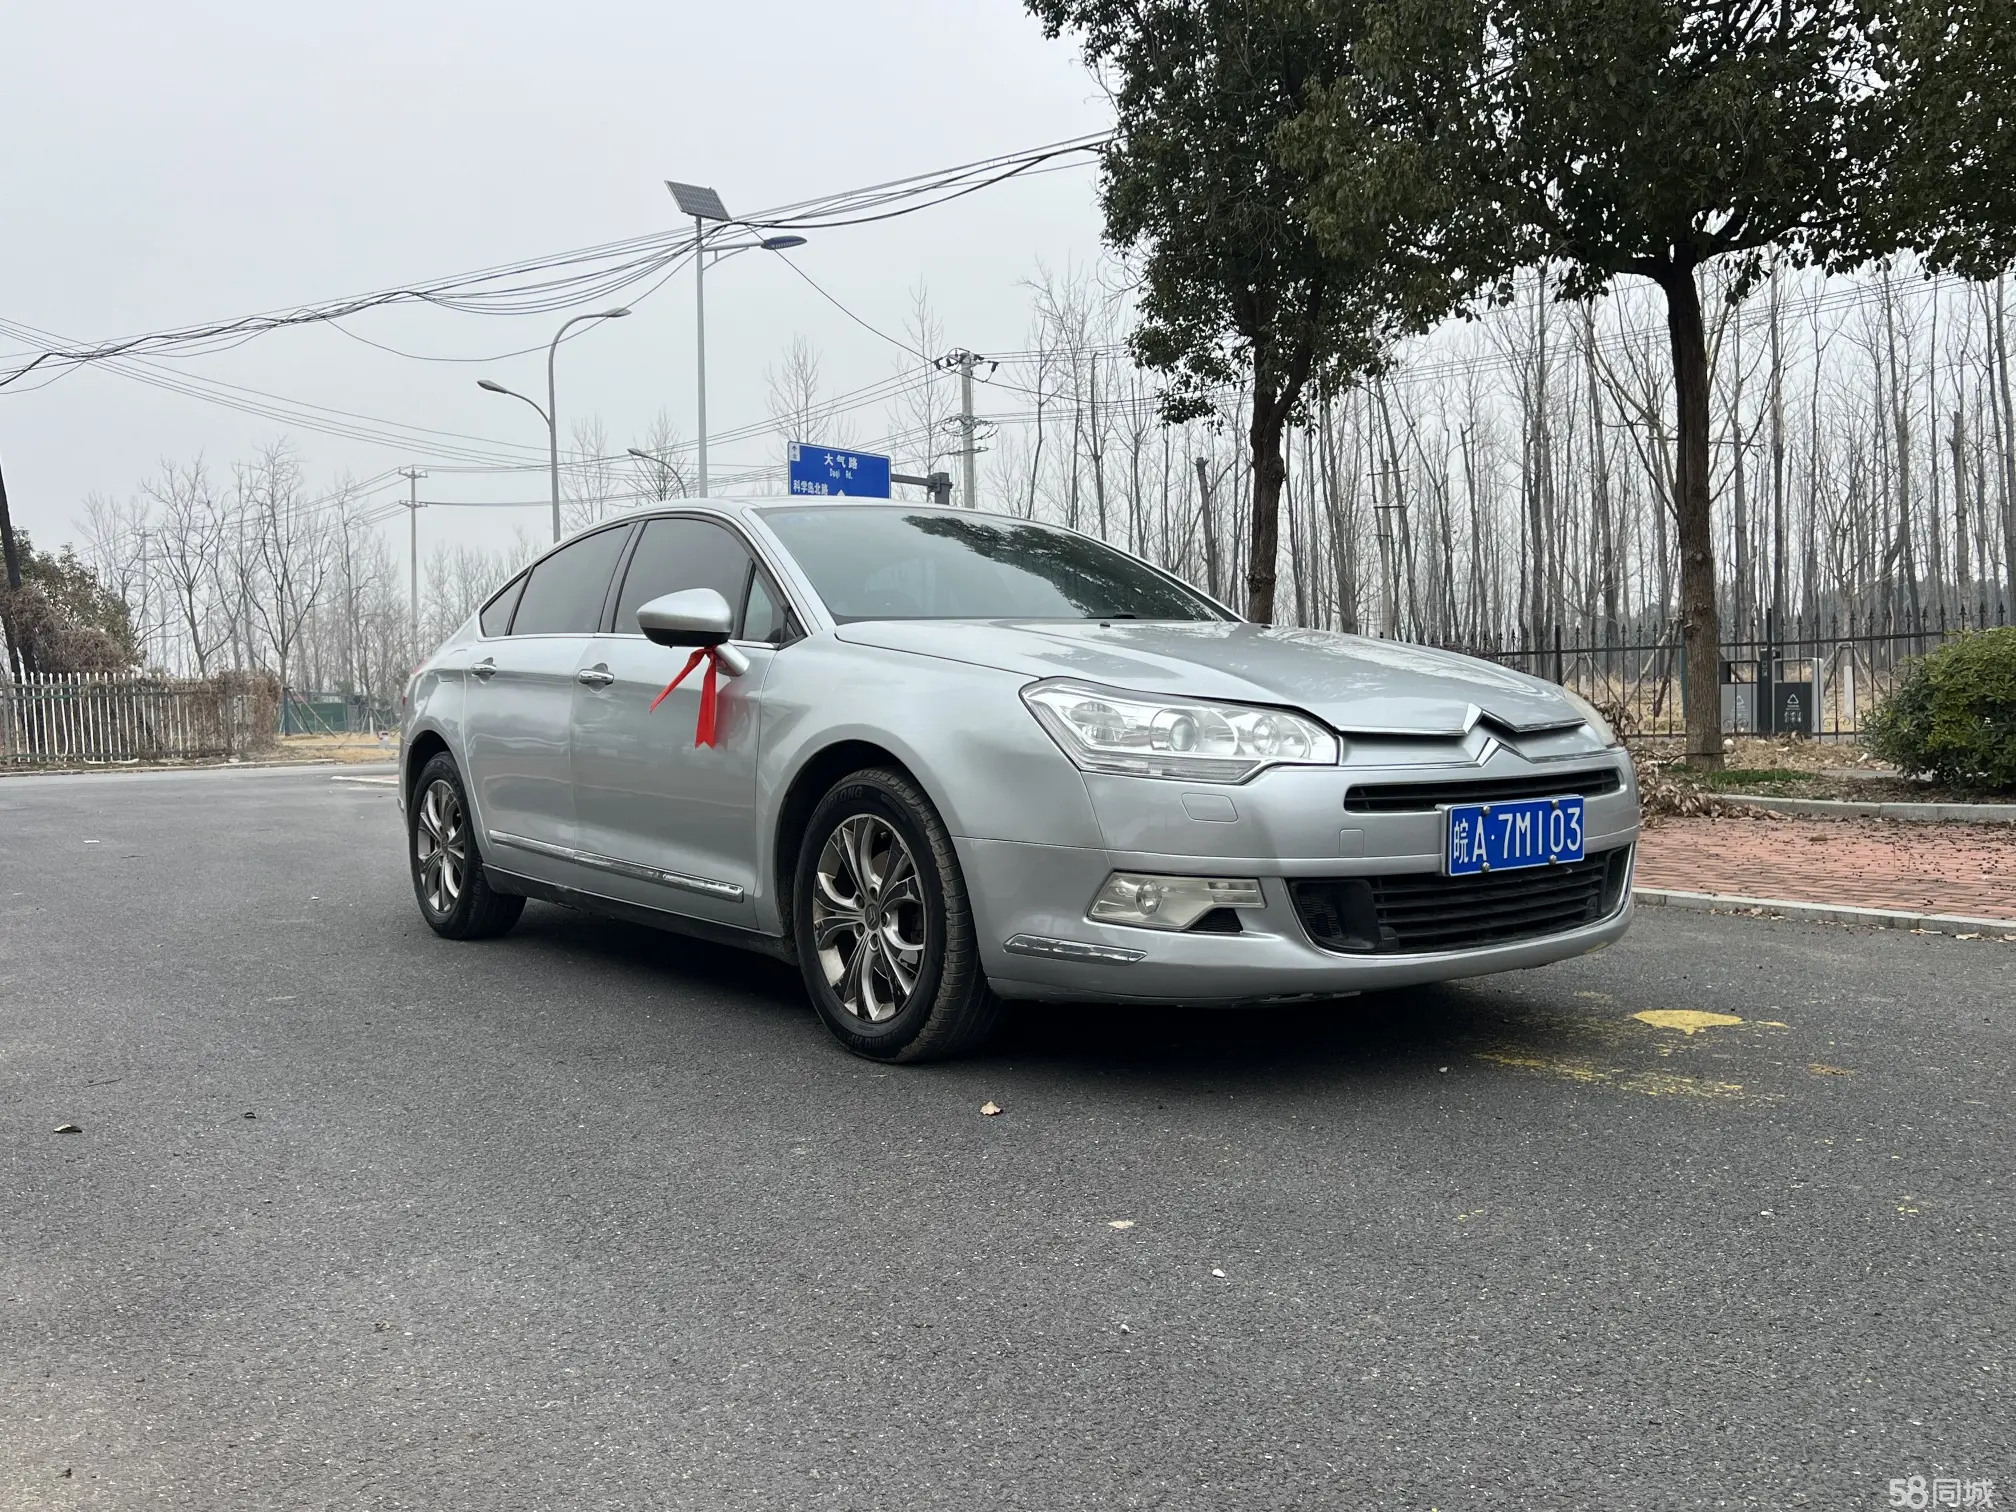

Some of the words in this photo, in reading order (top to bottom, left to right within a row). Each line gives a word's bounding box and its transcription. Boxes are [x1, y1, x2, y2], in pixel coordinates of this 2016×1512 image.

[824, 453, 858, 469] 大气路
[793, 480, 828, 496] 科学岛北路
